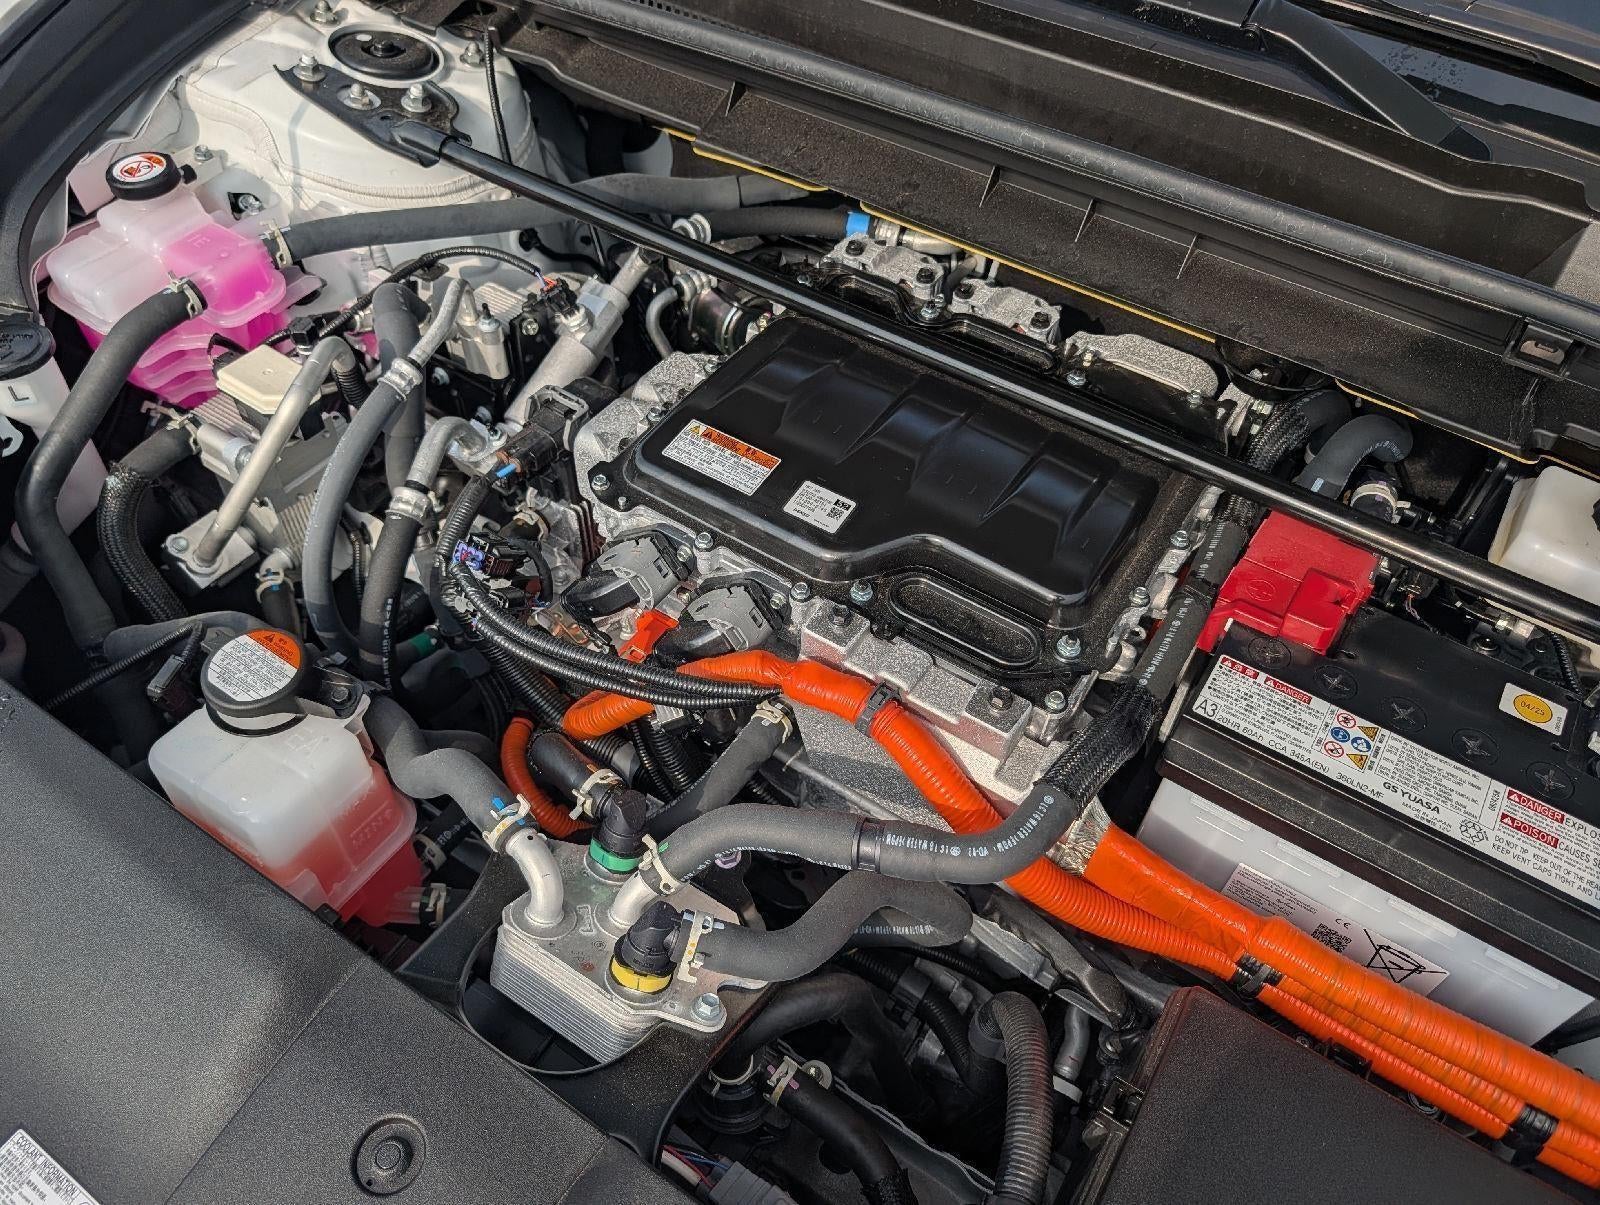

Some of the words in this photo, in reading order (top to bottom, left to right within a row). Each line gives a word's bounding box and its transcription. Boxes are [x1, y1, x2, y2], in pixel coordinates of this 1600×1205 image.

[1195, 699, 1219, 718] A3
[1275, 683, 1311, 704] DANGER
[1219, 715, 1241, 730] 20HR
[1268, 739, 1288, 753] CCA
[1382, 781, 1399, 793] GS
[1399, 788, 1440, 814] YUASA
[1520, 798, 1561, 822] DANGER
[1513, 821, 1556, 846] POISON
[1558, 841, 1591, 863] CAUSES
[1492, 843, 1511, 855] KEEP
[1512, 852, 1531, 865] VENT
[1532, 863, 1552, 877] CAPS
[1554, 872, 1576, 888] TIGHT
[1577, 884, 1593, 896] AND
[1504, 840, 1520, 851] NOT
[1532, 853, 1548, 864] KEEP
[1550, 861, 1562, 872] OUT
[1563, 868, 1572, 877] OF
[1572, 872, 1585, 883] THE
[16, 1136, 43, 1164] COOLANT
[40, 1158, 80, 1198] INFORMATION
